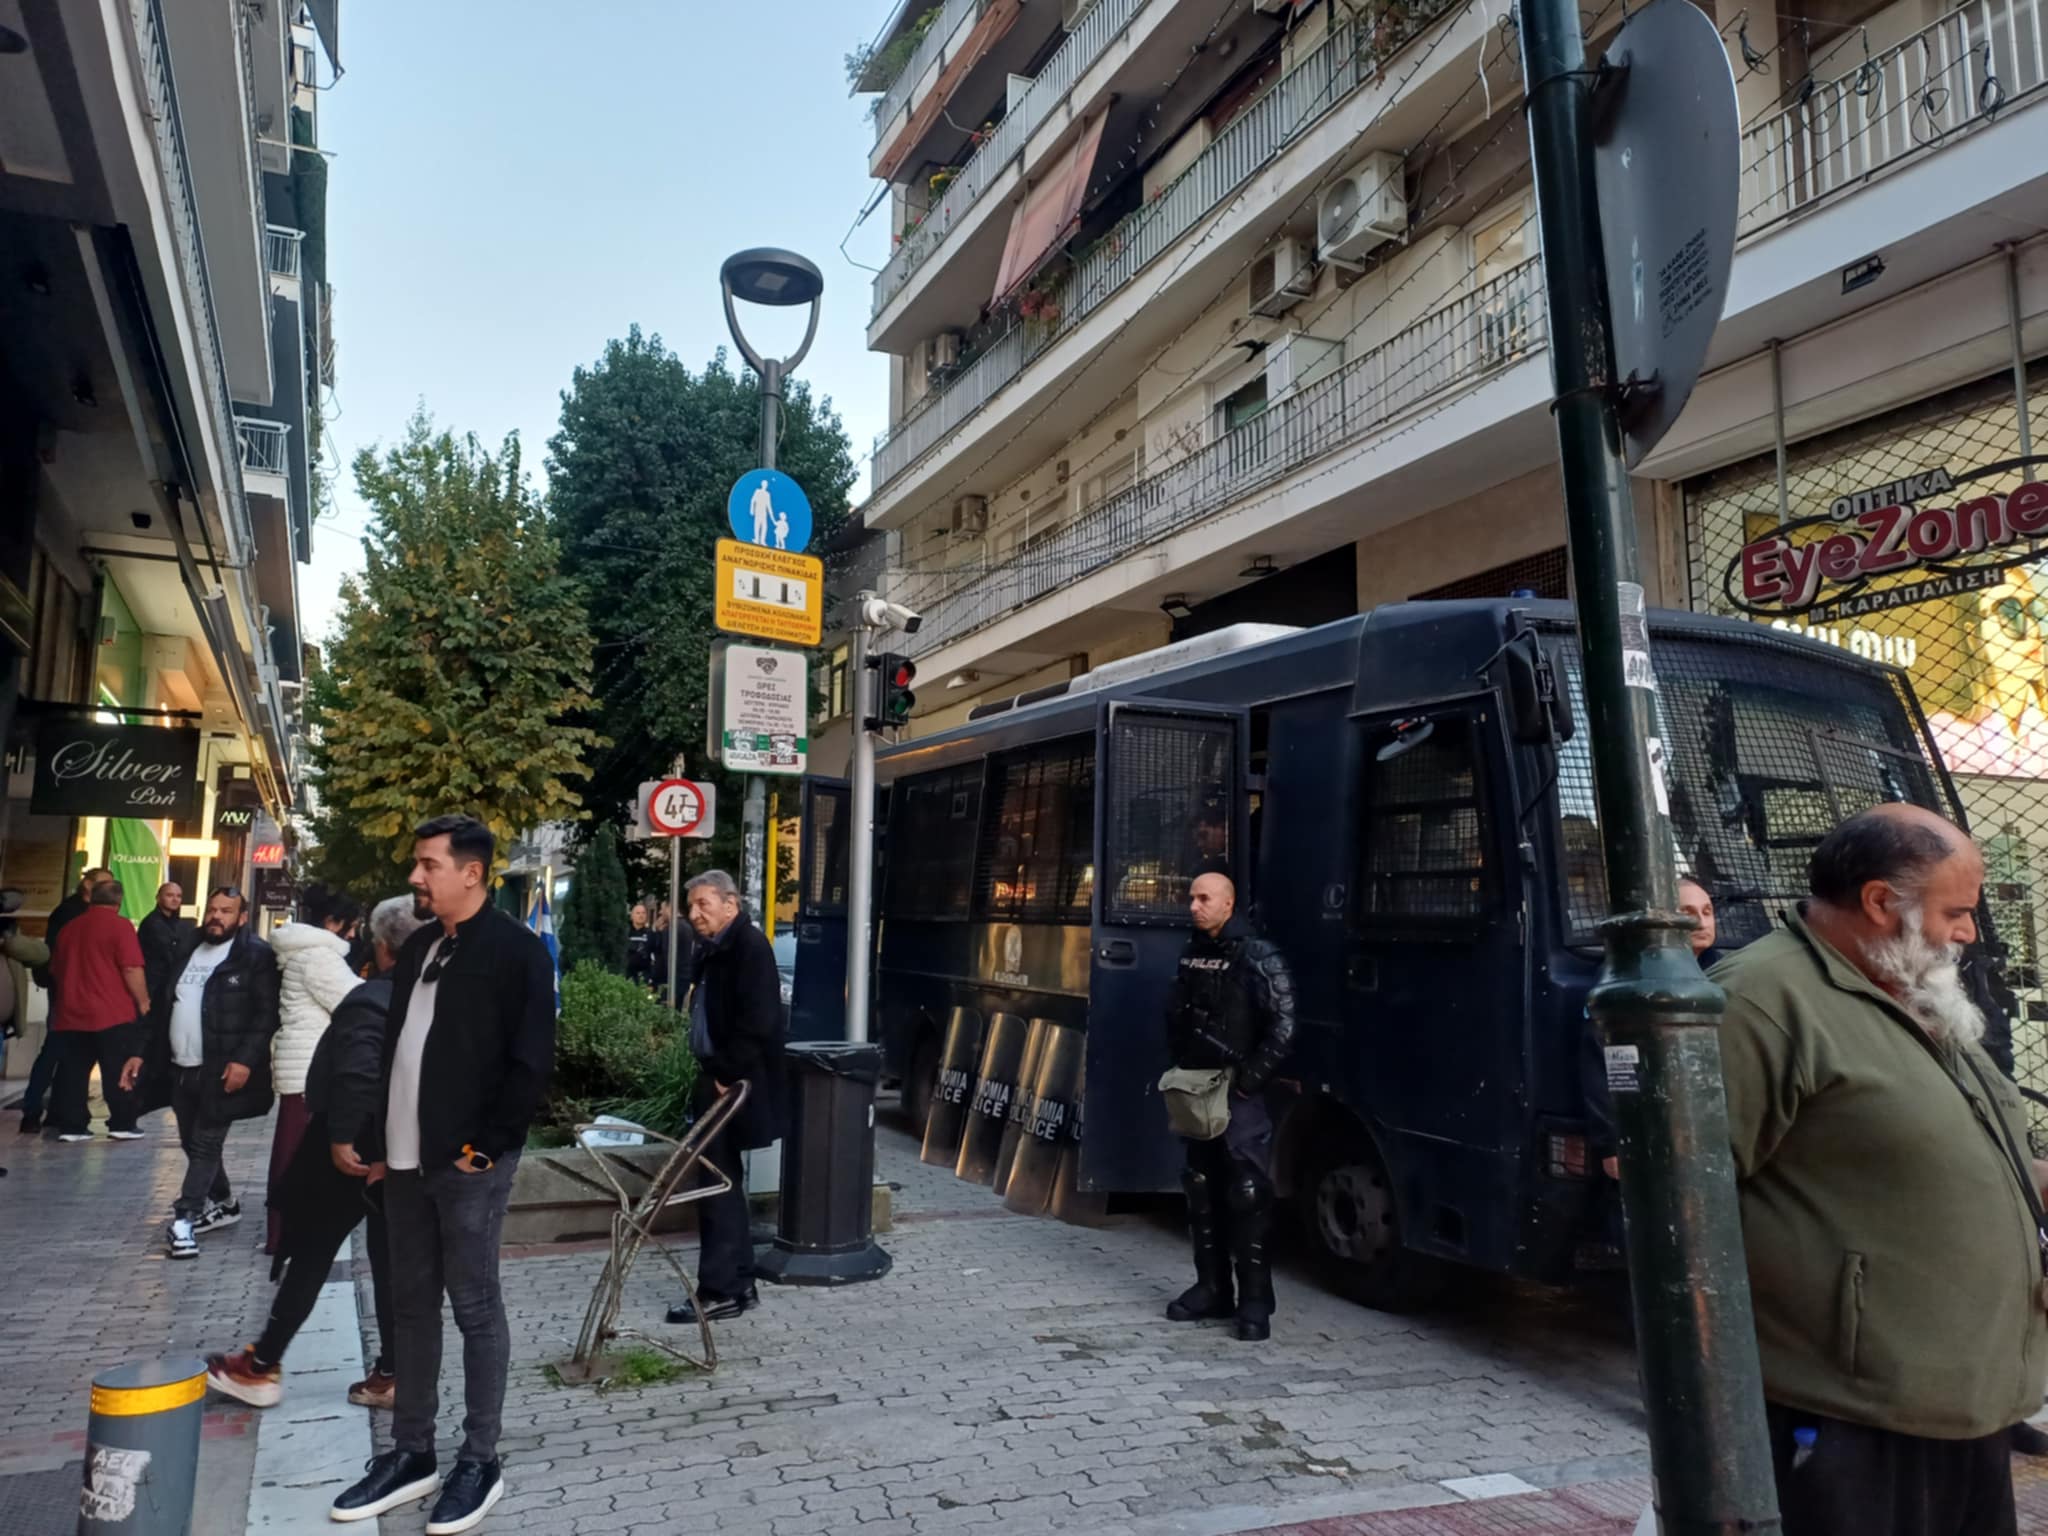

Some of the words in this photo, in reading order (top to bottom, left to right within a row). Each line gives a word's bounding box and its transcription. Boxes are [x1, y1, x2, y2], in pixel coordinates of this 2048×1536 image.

[1830, 467, 1951, 521] ΟΠΤΙΚΑ
[1742, 481, 2048, 606] EyeZone
[1839, 568, 2000, 616] ΚΑΡΑΠΑΛΙΣΗ
[51, 739, 182, 787] Silver
